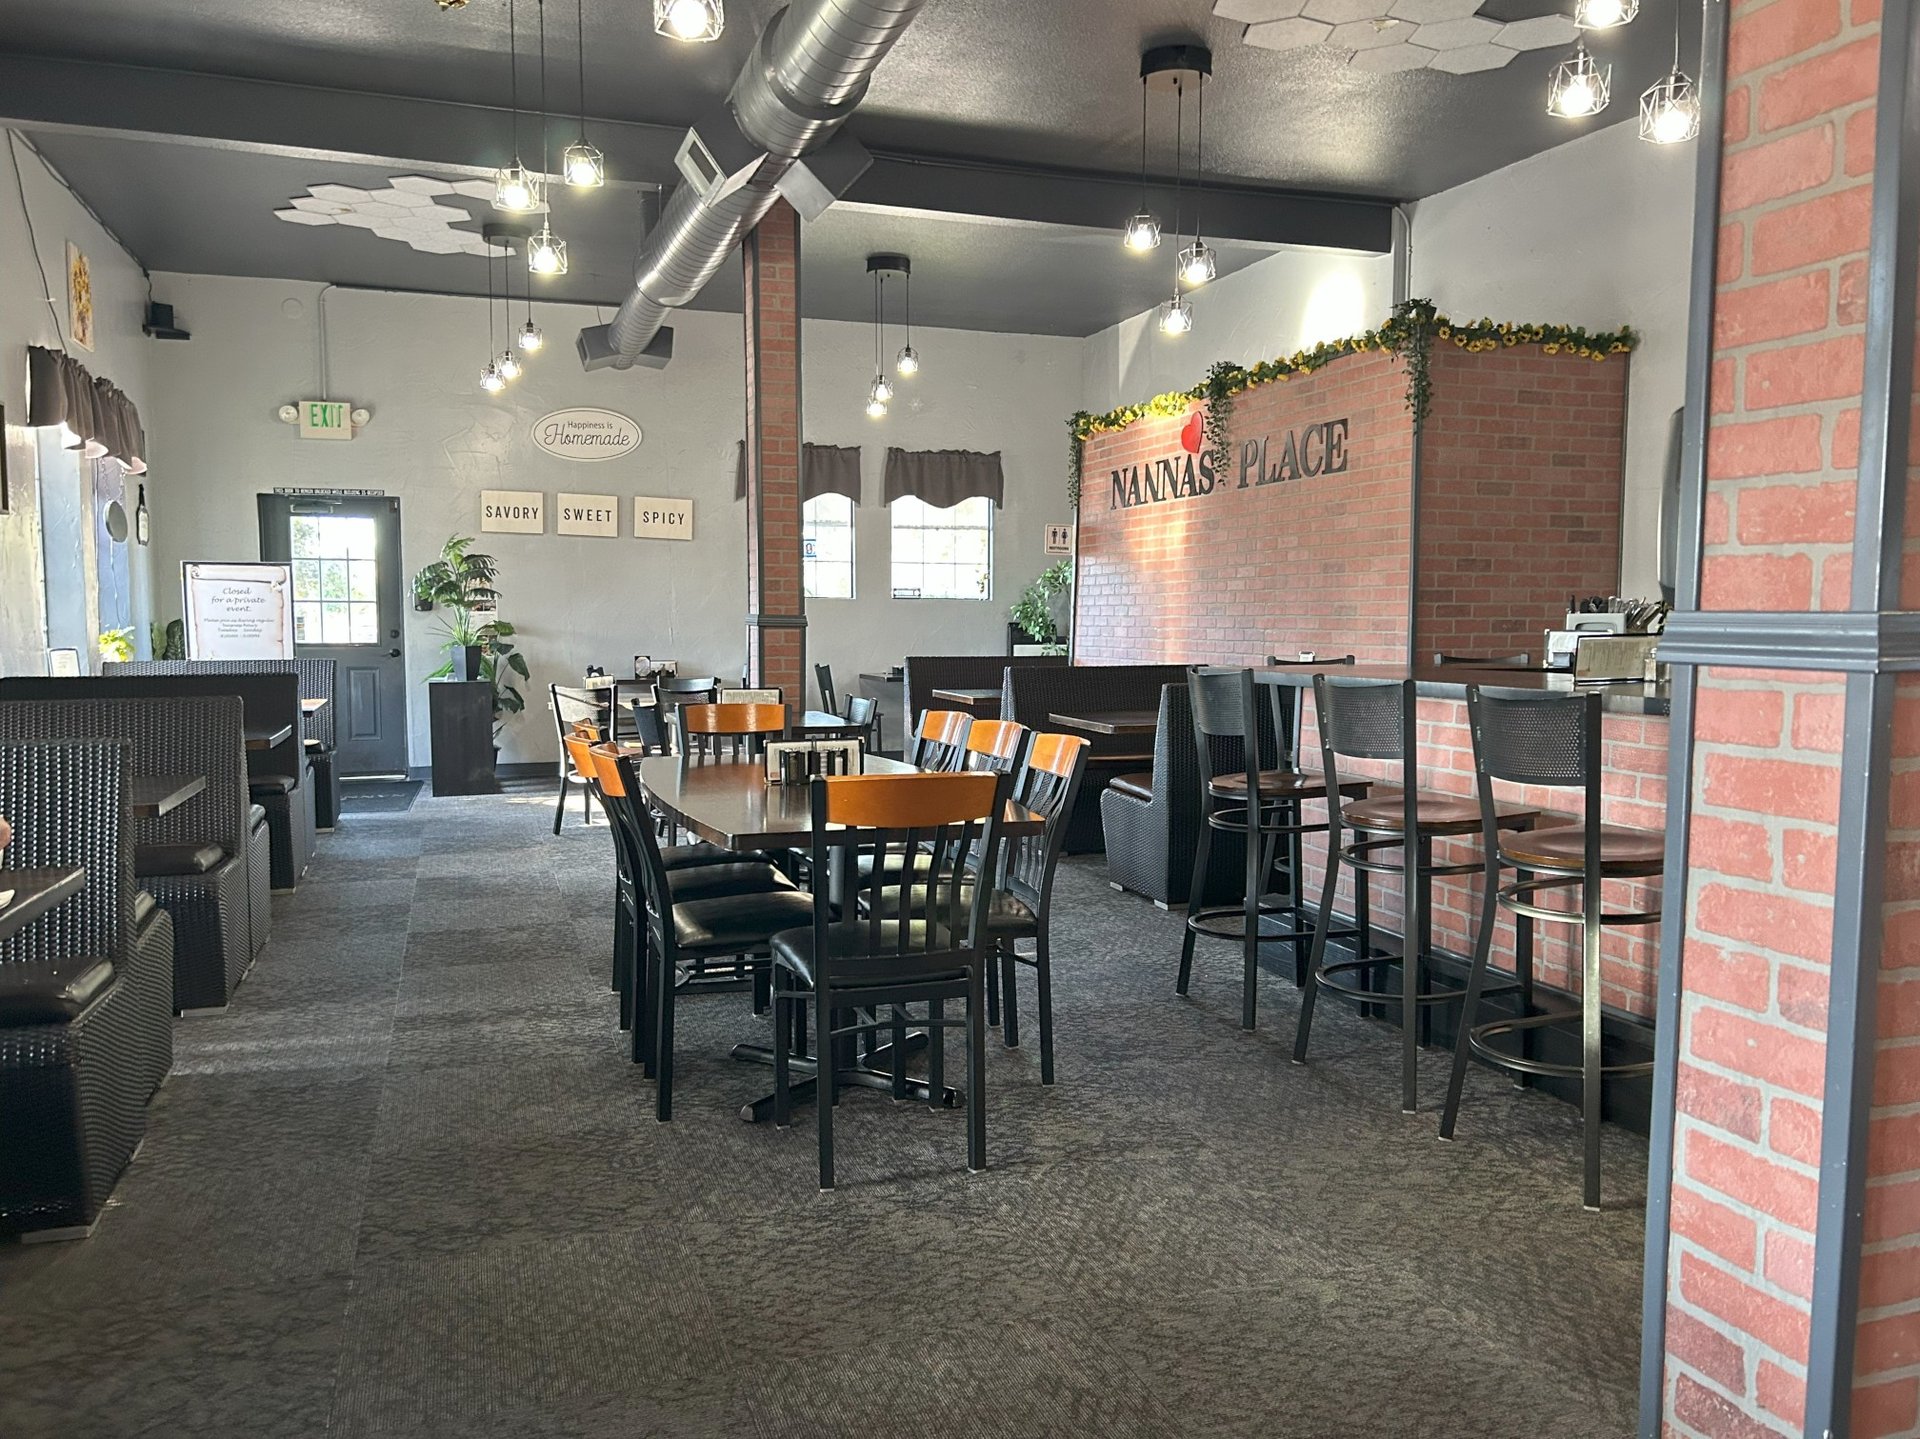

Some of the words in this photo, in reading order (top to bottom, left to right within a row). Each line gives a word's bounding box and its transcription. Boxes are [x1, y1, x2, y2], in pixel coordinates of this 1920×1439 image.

[310, 404, 343, 428] EXIT
[567, 420, 605, 430] Happiness
[606, 421, 613, 429] is
[544, 423, 630, 446] Homemade
[1110, 449, 1217, 510] NANNAS
[1237, 418, 1349, 489] PLACE
[485, 505, 539, 520] SAVORY
[563, 507, 612, 523] SWEET
[642, 511, 685, 526] SPICY
[222, 587, 252, 595] Closed
[211, 596, 224, 604] for
[234, 597, 266, 605] private
